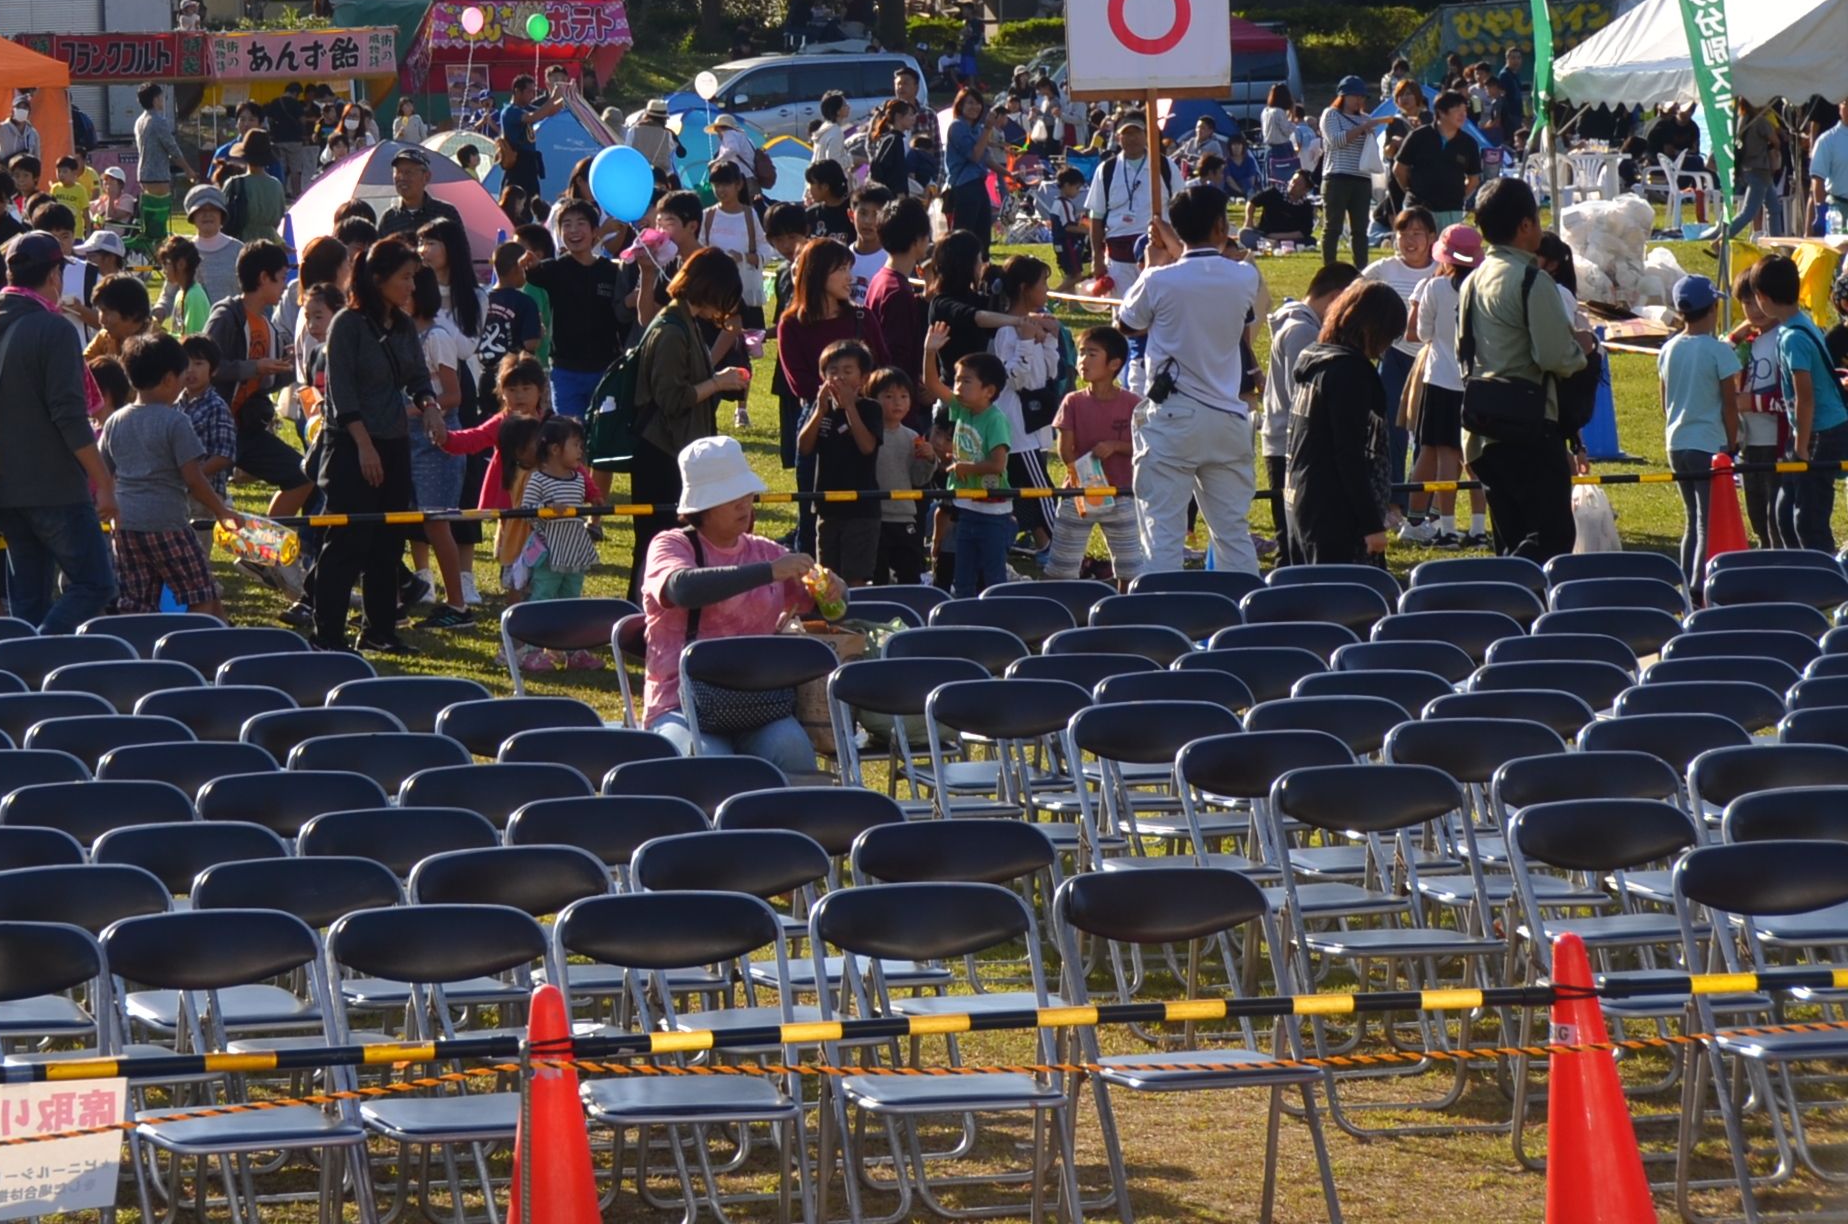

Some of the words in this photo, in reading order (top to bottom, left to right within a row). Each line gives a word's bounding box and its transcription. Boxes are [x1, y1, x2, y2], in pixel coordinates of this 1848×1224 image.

[546, 5, 615, 41] ポテト
[60, 41, 172, 75] フランクフルト
[247, 36, 359, 73] あんず飴
